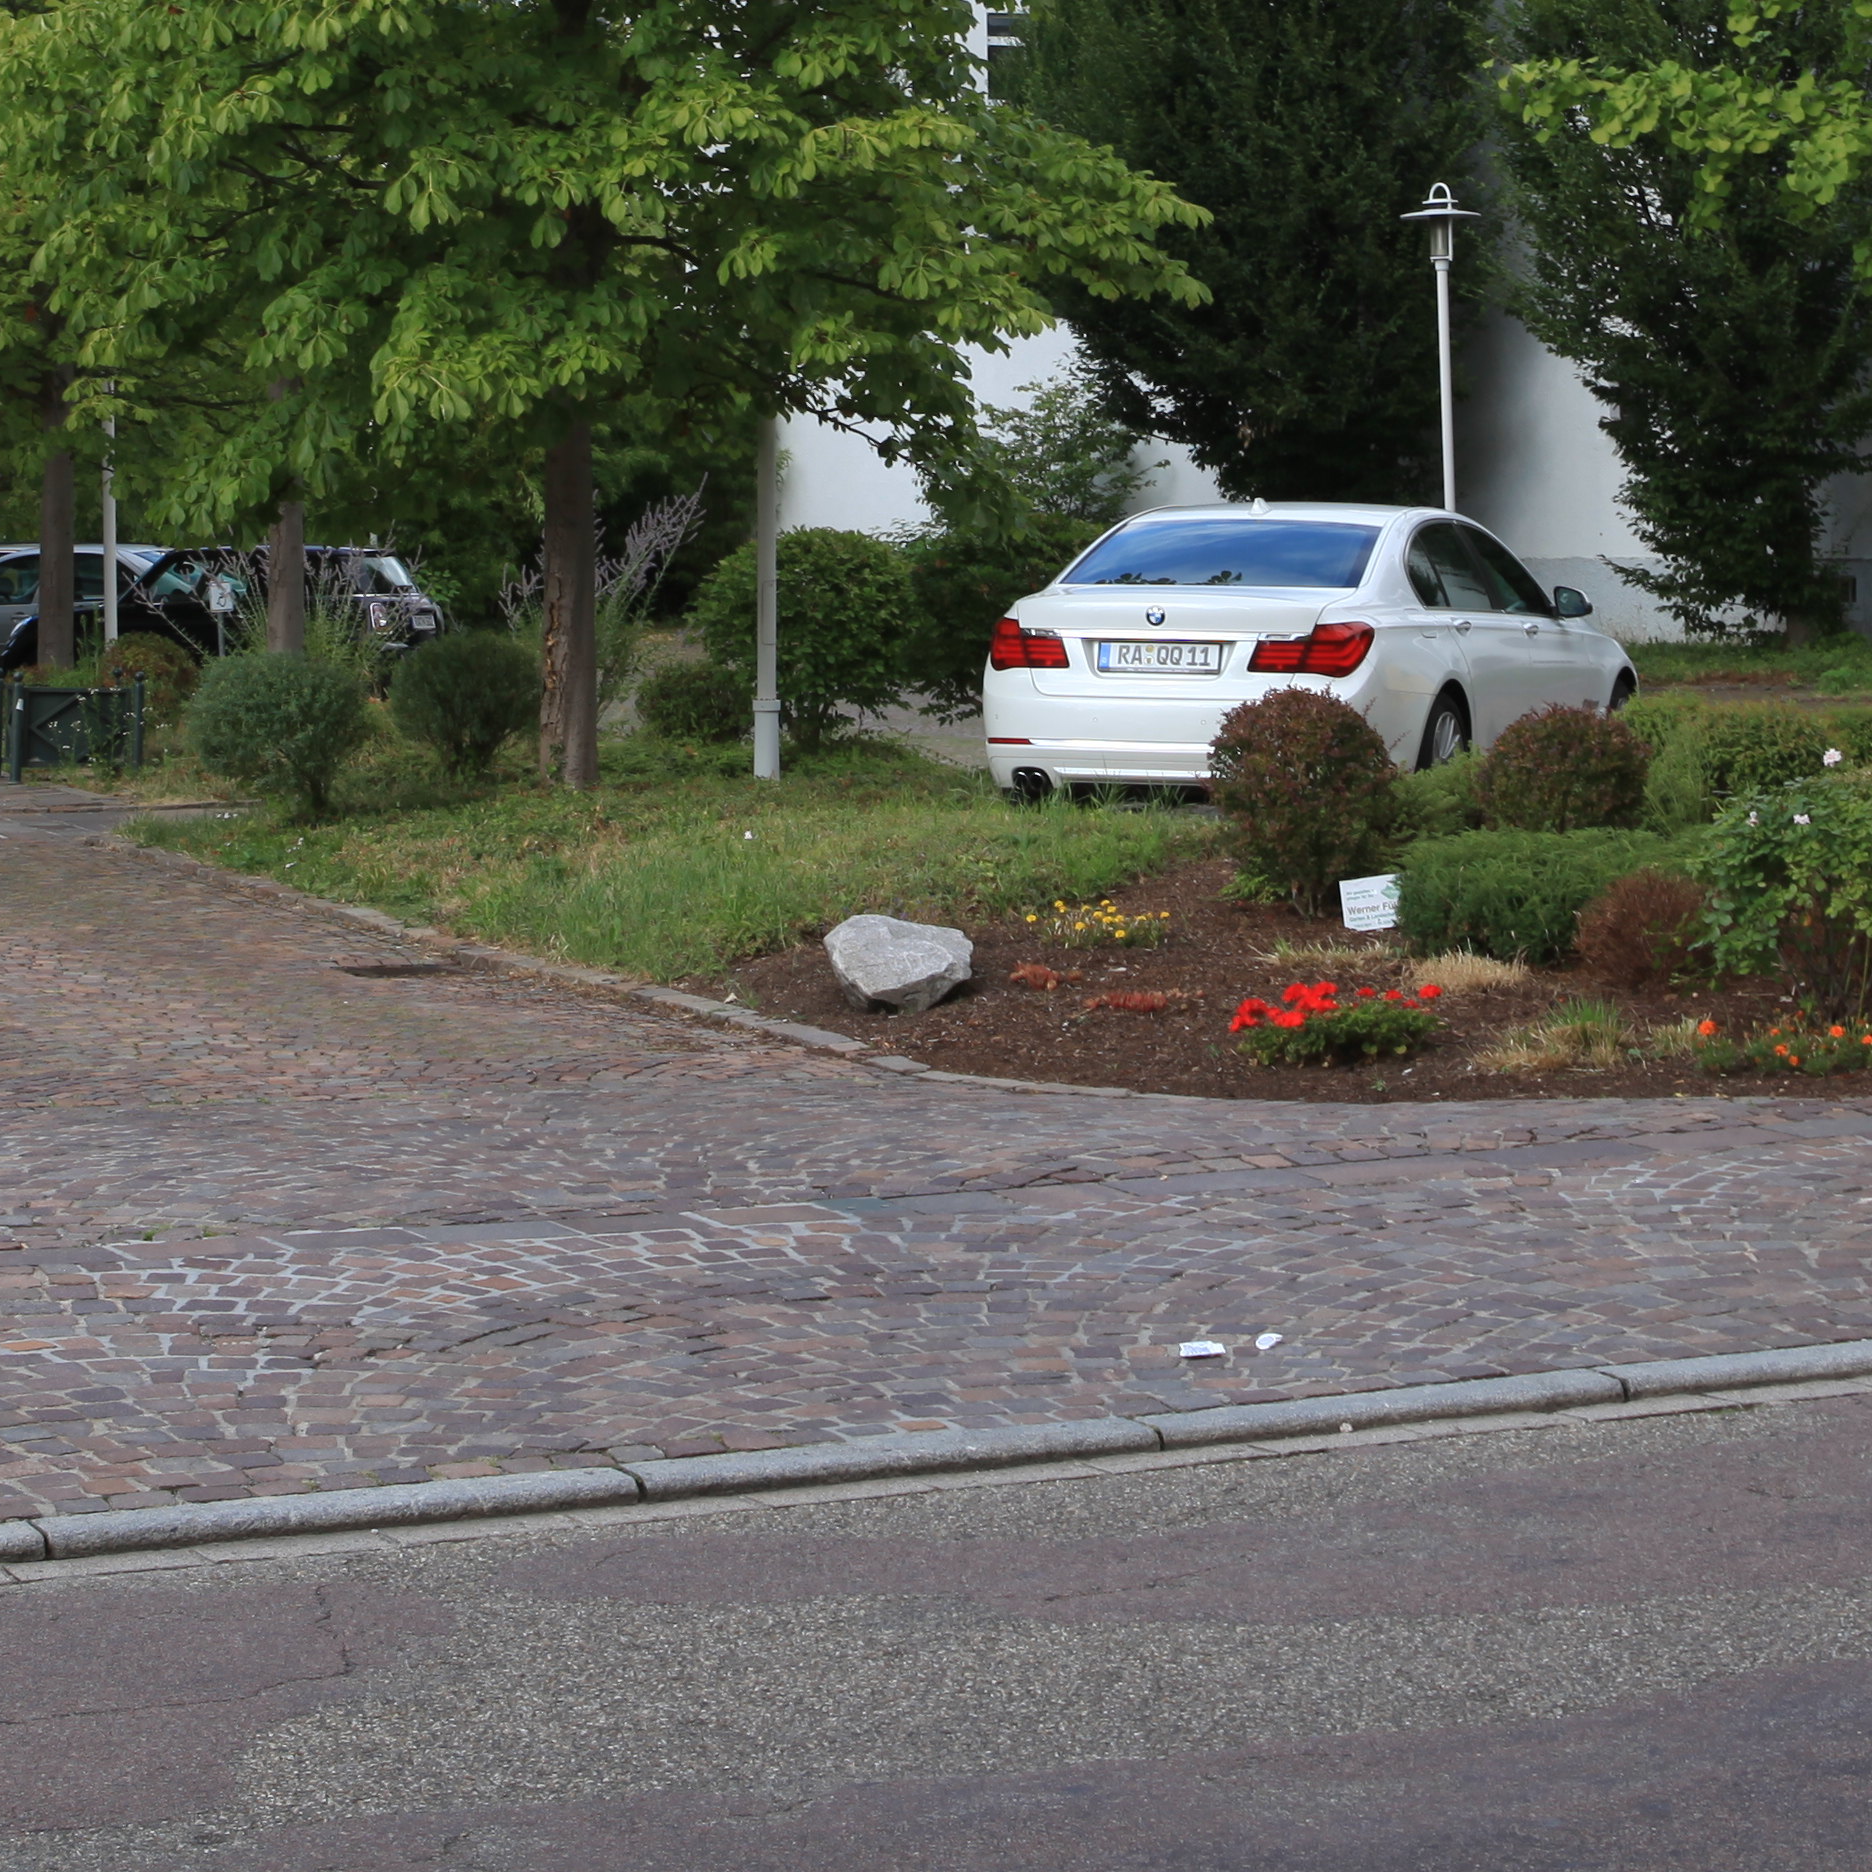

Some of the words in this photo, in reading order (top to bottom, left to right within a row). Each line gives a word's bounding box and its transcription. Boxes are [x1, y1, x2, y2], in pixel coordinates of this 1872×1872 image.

[1117, 645, 1143, 665] RA
[1157, 646, 1183, 666] QQ
[1186, 647, 1211, 667] 11
[1347, 904, 1380, 916] Werner
